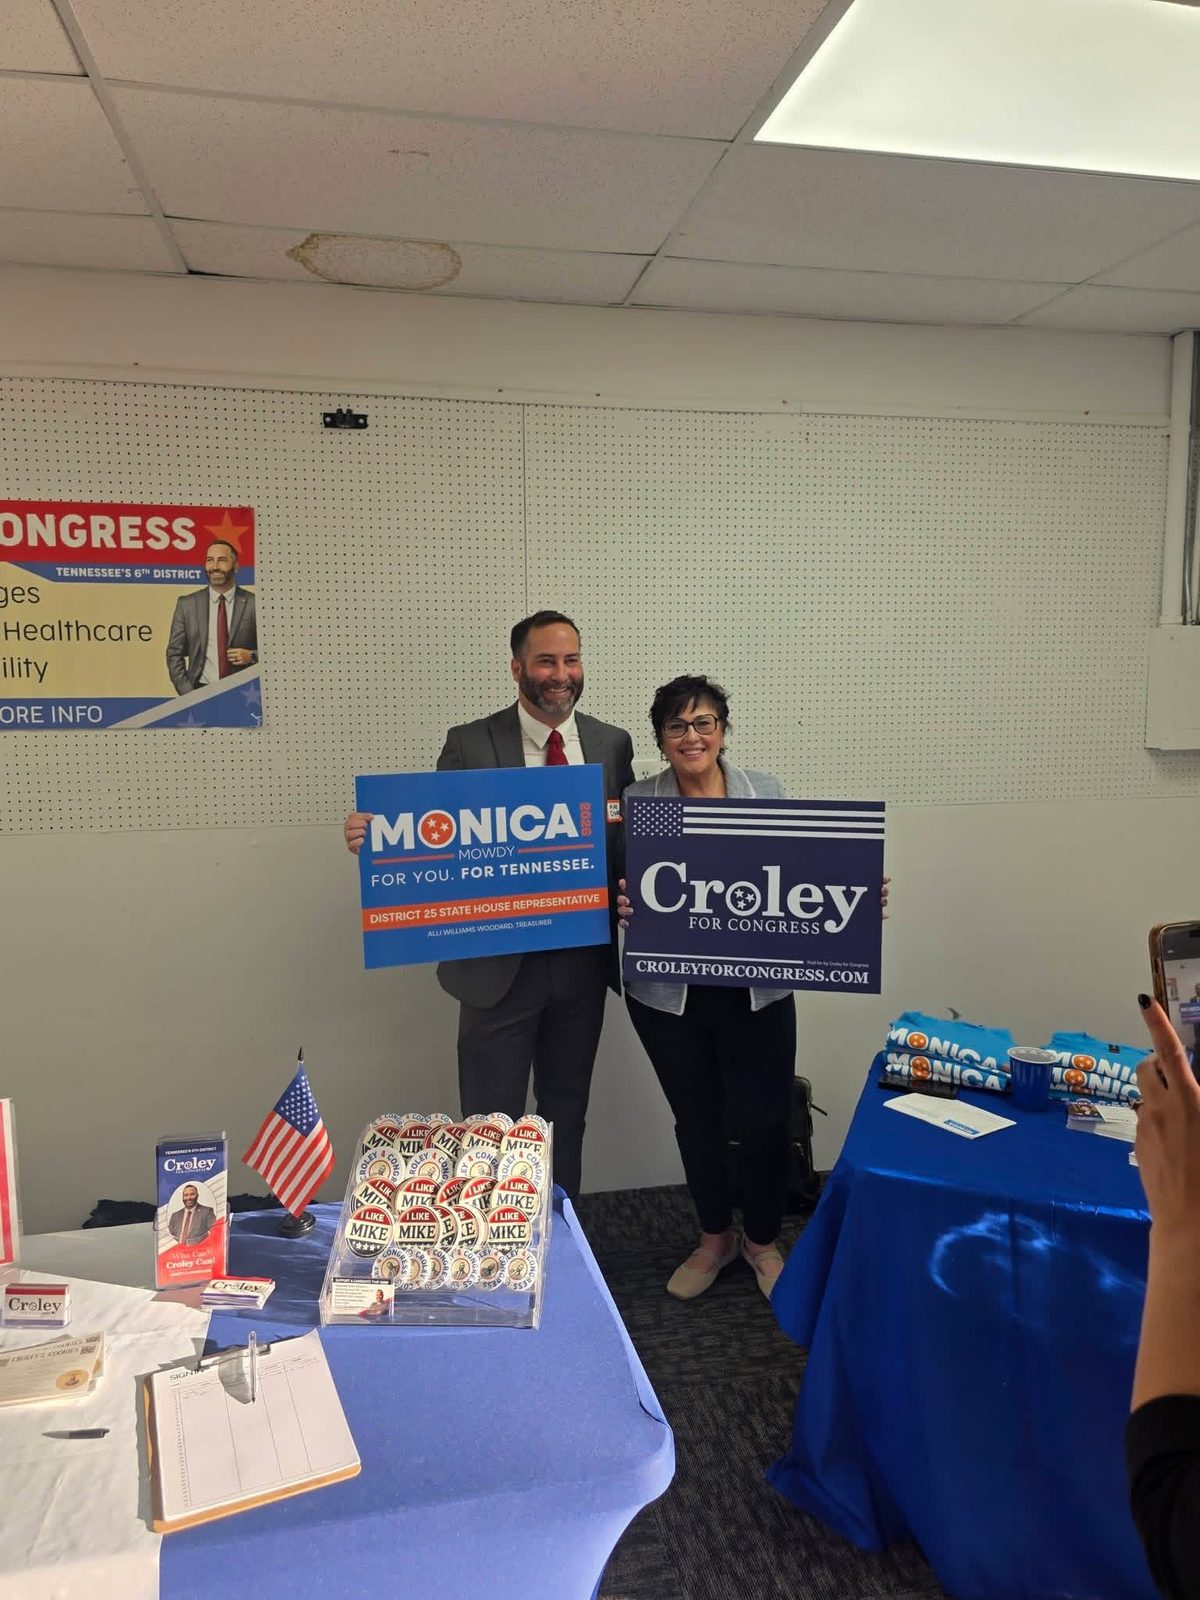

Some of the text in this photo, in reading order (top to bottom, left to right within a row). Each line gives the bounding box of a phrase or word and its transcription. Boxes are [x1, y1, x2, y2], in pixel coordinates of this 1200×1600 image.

[56, 567, 131, 578] TENNESSEE'S
[153, 569, 201, 579] DISTRICT
[4, 619, 152, 642] Healthcare
[2, 656, 48, 683] ility
[51, 705, 103, 723] INFO
[370, 803, 579, 852] MONICA
[459, 846, 516, 861] MOWDY
[371, 858, 595, 888] FOR YOU. FOR TENNESSEE.
[640, 861, 868, 934] Croley
[370, 893, 601, 924] DISTRICT 25 STATE HOUSE REPRESENTATIVE
[443, 926, 476, 936] WILLIAMS
[515, 918, 552, 928] TREASURER
[689, 916, 820, 935] FOR CONGRESS
[636, 959, 869, 984] CROLEYFORCONGRESS.COM
[887, 1027, 998, 1070] MONICA
[886, 1053, 1002, 1091] MONICA
[1047, 1049, 1137, 1084] MONI
[519, 1129, 538, 1139] LIKE
[400, 1140, 422, 1153] MIK
[436, 1132, 460, 1158] MIK
[163, 1156, 217, 1172] Croley
[387, 1153, 400, 1183] CONGR
[409, 1152, 428, 1175] ROLEY
[526, 1153, 543, 1186] CONGRE
[379, 1184, 392, 1197] LIK
[416, 1183, 435, 1192] LIKE
[473, 1181, 492, 1193] LIKE
[510, 1182, 530, 1191] LIKE
[496, 1193, 535, 1210] MIKE
[365, 1212, 385, 1222] LIKE
[411, 1212, 430, 1220] LIKE
[500, 1212, 520, 1220] LIKE
[350, 1223, 388, 1241] MIKE
[399, 1225, 436, 1239] MIKE
[489, 1224, 527, 1240] MIKE
[212, 1281, 261, 1292] Croley
[8, 1297, 62, 1312] Croley
